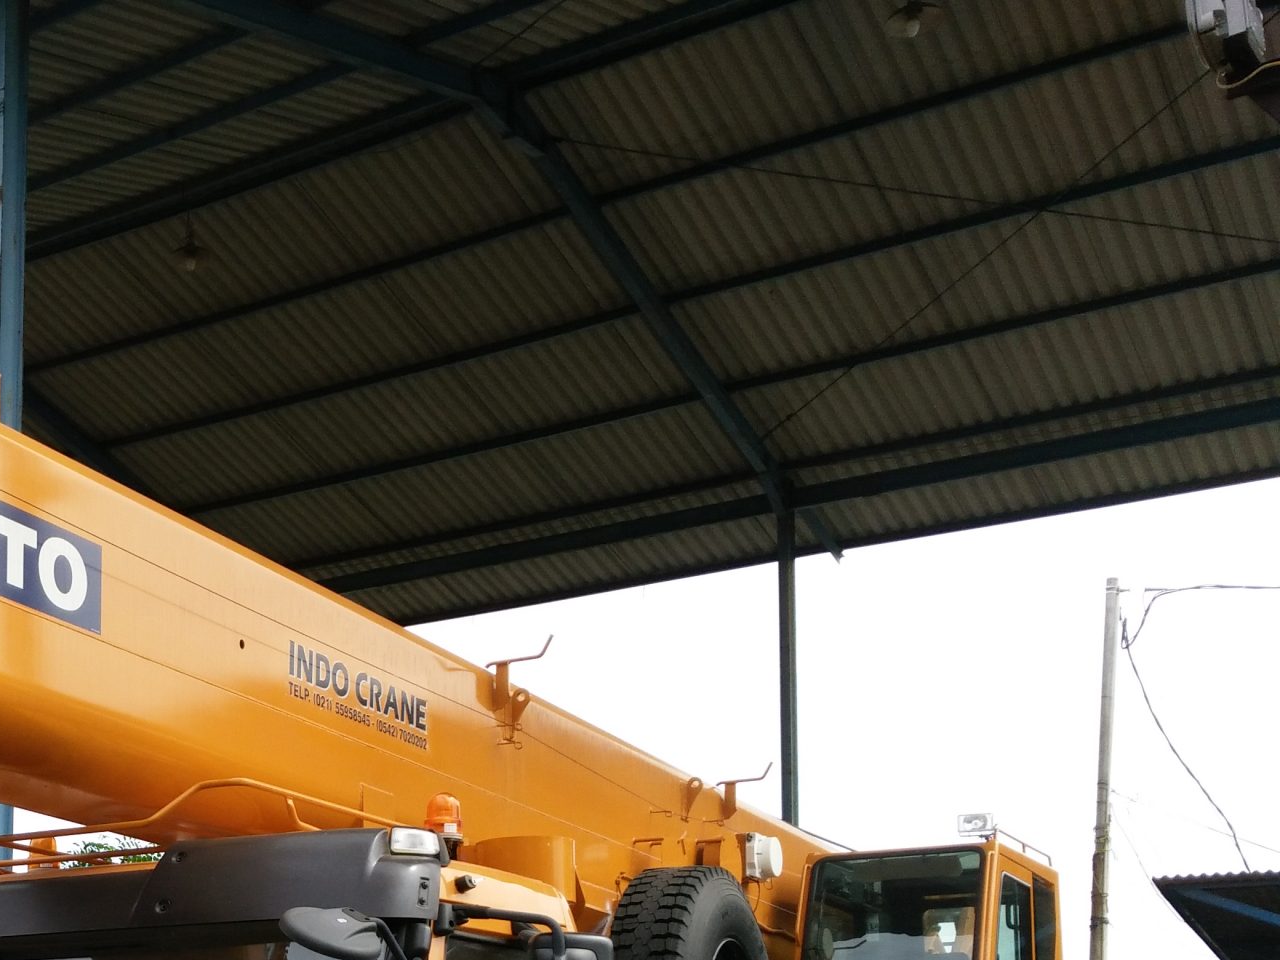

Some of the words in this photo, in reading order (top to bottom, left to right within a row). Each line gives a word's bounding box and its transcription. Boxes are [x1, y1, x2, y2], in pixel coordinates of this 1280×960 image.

[289, 640, 349, 697] INDO
[355, 672, 427, 731] CRANE
[289, 682, 310, 702] TELP.
